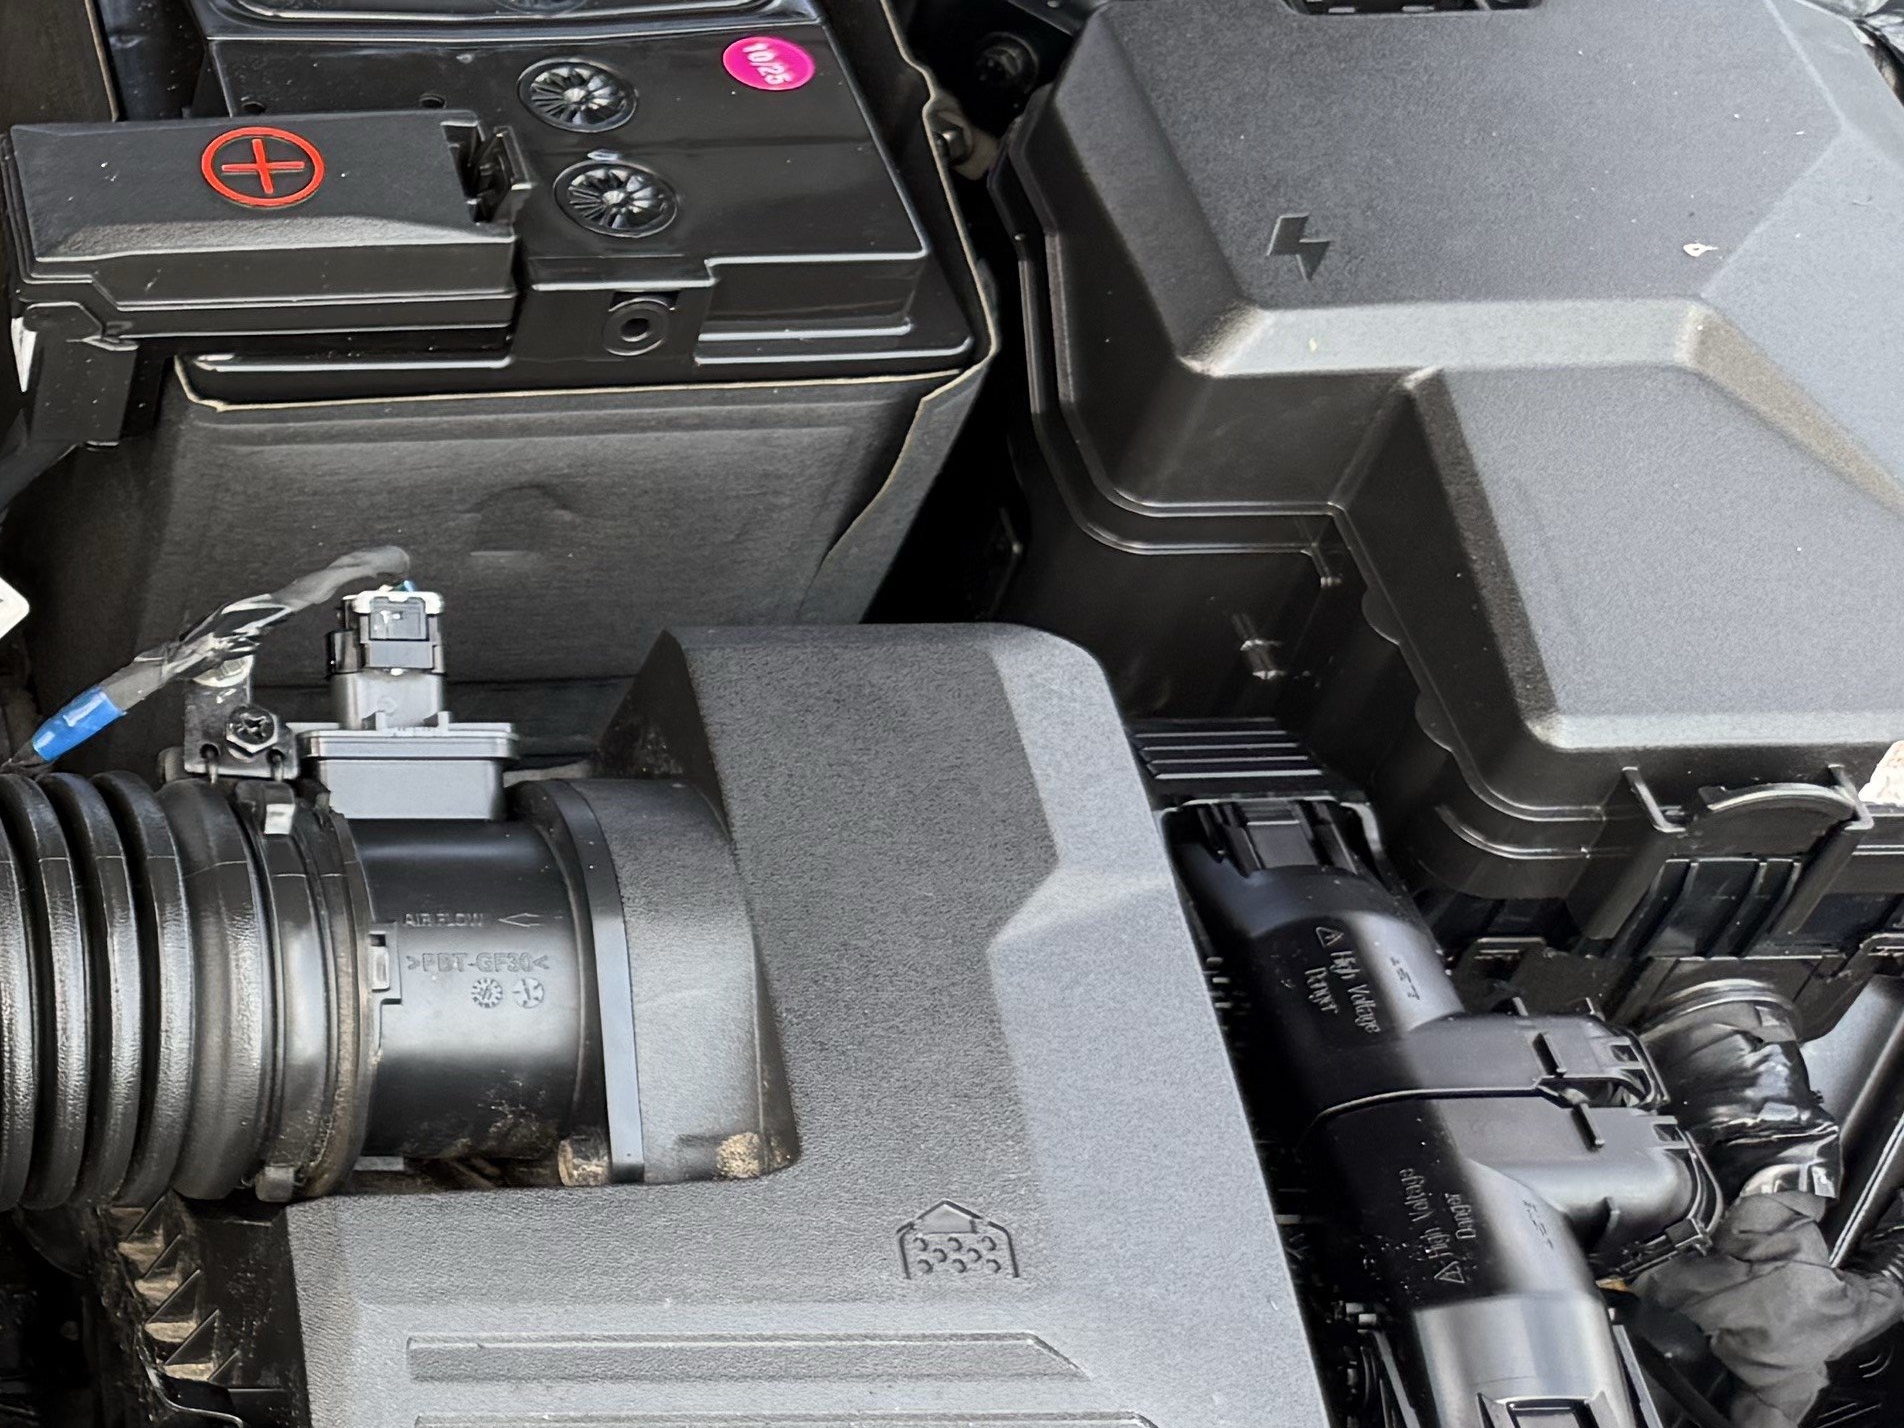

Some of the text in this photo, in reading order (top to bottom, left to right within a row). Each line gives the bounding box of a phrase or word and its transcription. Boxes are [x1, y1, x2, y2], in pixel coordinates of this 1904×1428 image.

[742, 42, 794, 85] 10/25
[1304, 966, 1339, 1014] Danger
[1329, 950, 1382, 1033] High Voltage
[1399, 1167, 1455, 1260] High Voltage
[1444, 1193, 1477, 1240] Danger
